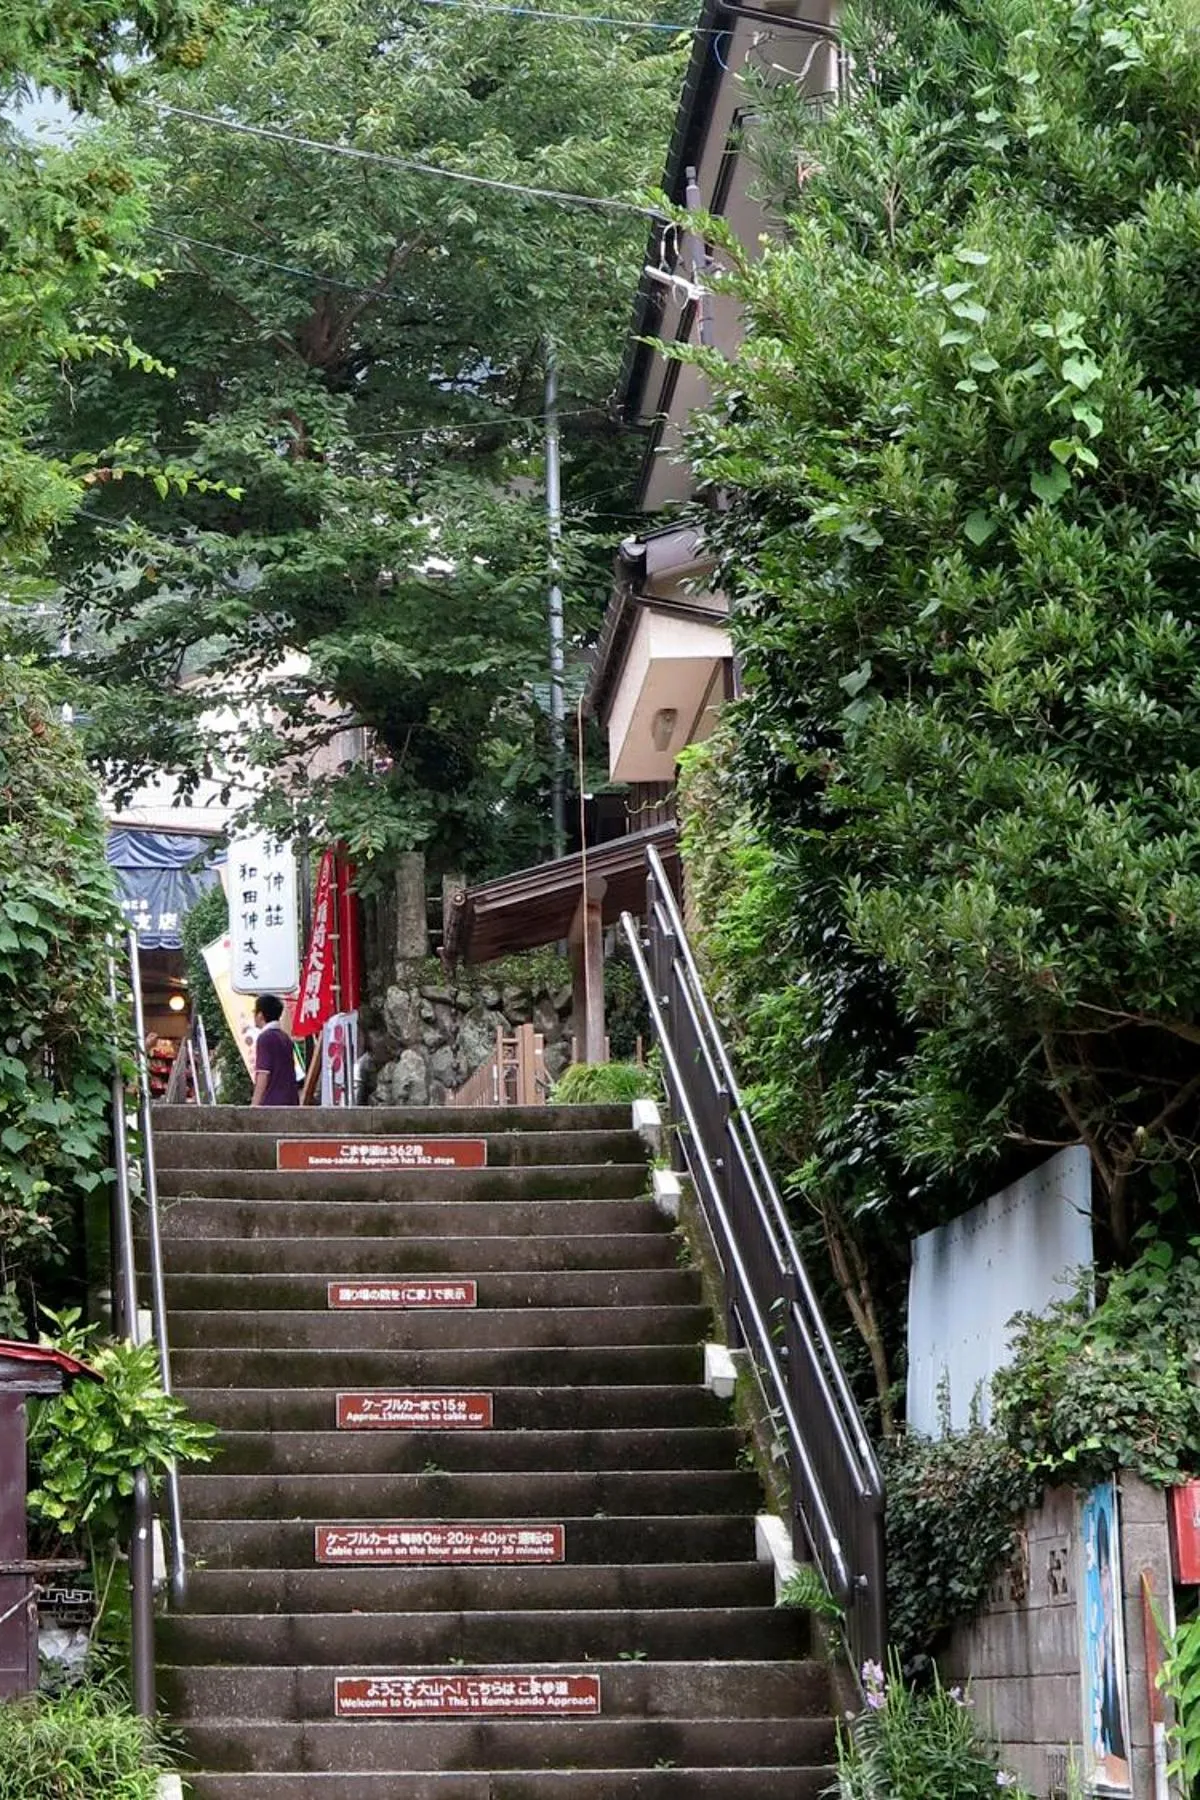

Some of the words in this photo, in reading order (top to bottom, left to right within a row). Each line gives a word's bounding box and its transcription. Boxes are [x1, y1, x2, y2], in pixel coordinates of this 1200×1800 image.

[431, 1412, 442, 1421] to
[443, 1412, 467, 1421] cable
[469, 1413, 484, 1421] car
[325, 1546, 352, 1556] Cable
[354, 1546, 374, 1556] cars
[376, 1547, 393, 1556] run
[395, 1547, 408, 1556] on
[409, 1546, 425, 1556] the
[428, 1546, 451, 1556] hour
[453, 1546, 471, 1556] and
[473, 1546, 500, 1557] every
[502, 1546, 514, 1556] 20
[516, 1546, 554, 1556] minutes
[340, 1698, 388, 1708] Welcome
[390, 1699, 401, 1708] to
[448, 1697, 468, 1707] This
[470, 1698, 479, 1707] is
[481, 1697, 545, 1706] Koma-sando
[547, 1696, 596, 1708] Approach
